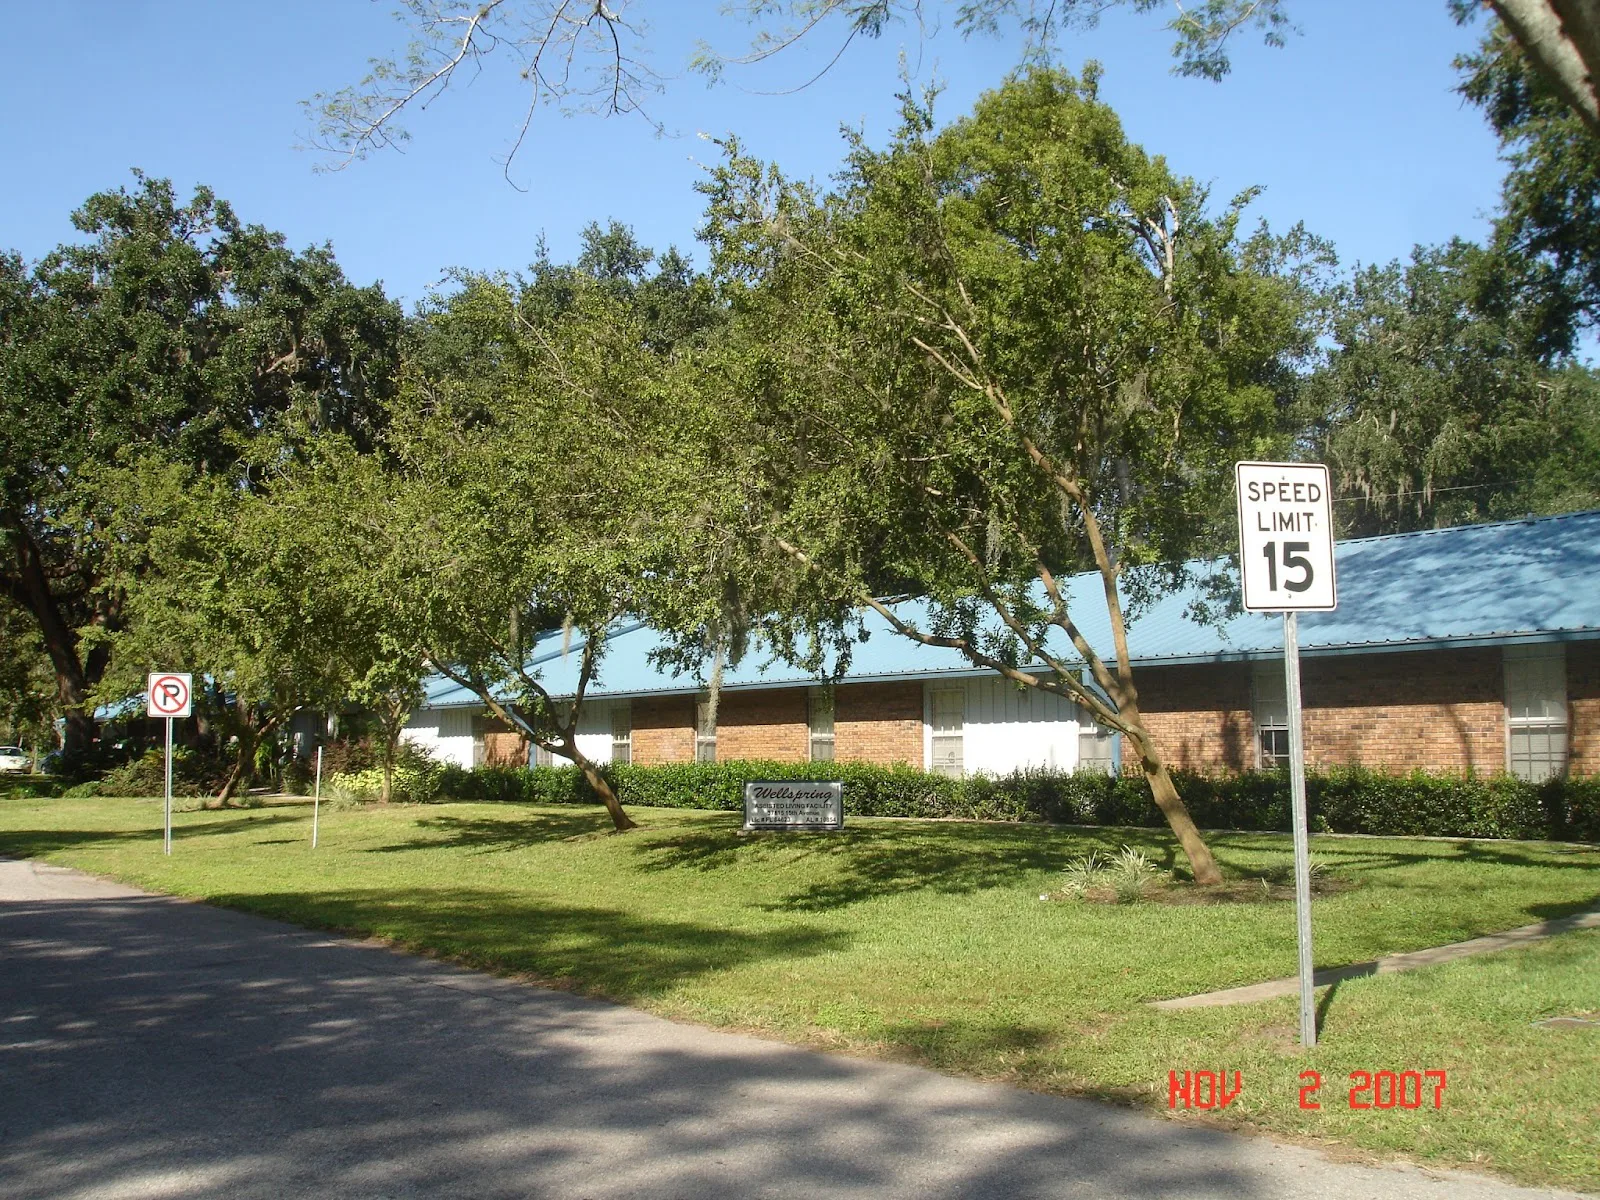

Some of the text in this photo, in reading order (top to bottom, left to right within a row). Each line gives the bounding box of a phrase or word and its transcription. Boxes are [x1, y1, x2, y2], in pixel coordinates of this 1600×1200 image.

[1248, 481, 1321, 503] SPEED
[1257, 511, 1314, 532] LIMIT
[1262, 541, 1314, 593] 15
[753, 787, 834, 803] Wellspring
